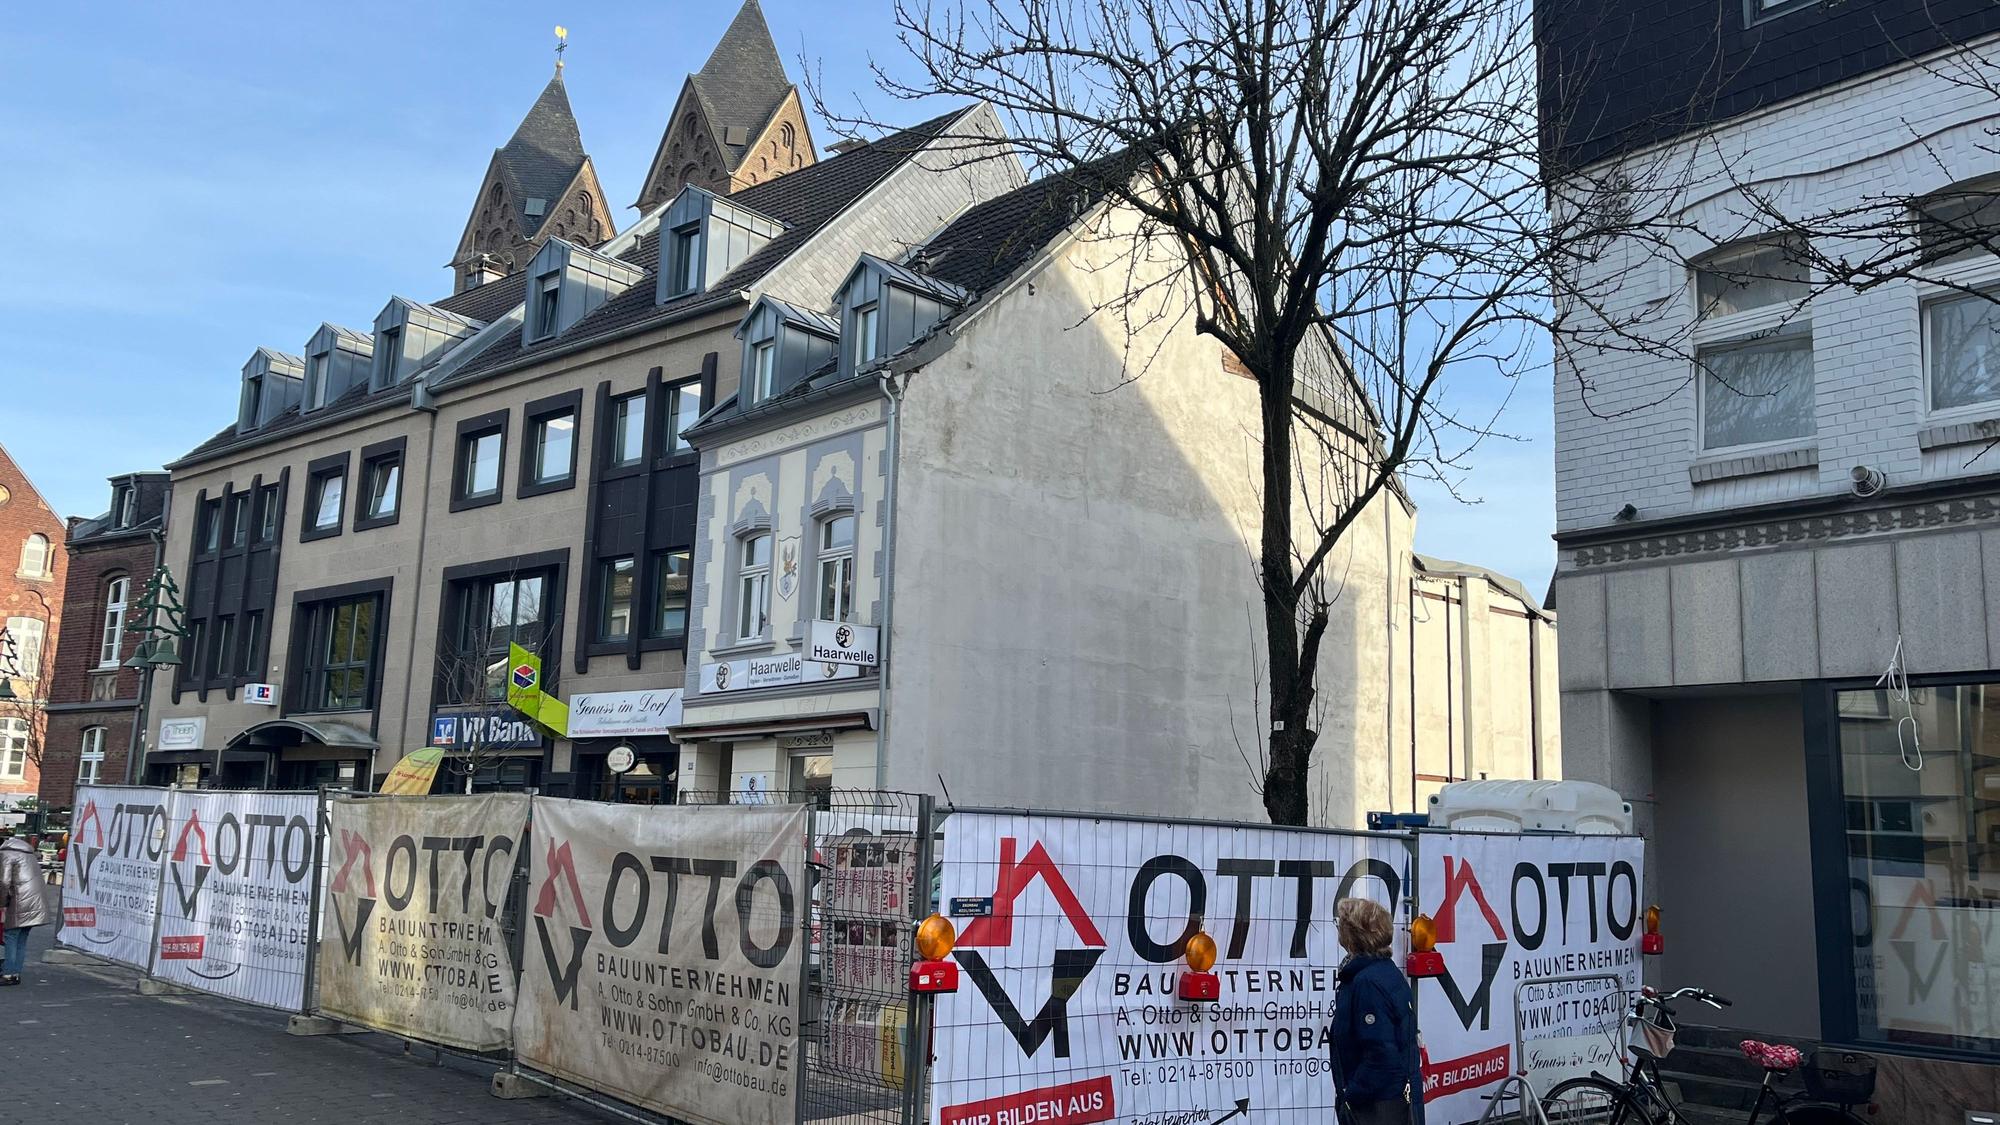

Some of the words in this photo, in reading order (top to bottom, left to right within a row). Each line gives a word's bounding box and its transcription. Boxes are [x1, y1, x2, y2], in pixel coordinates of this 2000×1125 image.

[751, 658, 801, 677] Haarwelle
[814, 645, 874, 663] Haarwelle
[576, 696, 615, 716] Genuss
[618, 700, 634, 713] im
[638, 691, 677, 717] Dorf
[463, 717, 486, 743] VR
[488, 716, 536, 743] Bank
[107, 803, 167, 862] OTTO
[214, 812, 312, 884] OTTO
[295, 911, 309, 924] KG
[602, 851, 795, 968] OTTO
[1126, 854, 1401, 963] OTTO
[1510, 860, 1637, 951] OTTO
[379, 940, 387, 954] A.
[389, 941, 408, 957] Otto
[410, 944, 417, 958] &
[421, 945, 445, 960] Sohn
[1514, 947, 1635, 980] BAUUNTERNEHMEN
[597, 953, 790, 1007] BAUUNTERNEHMEN
[1528, 986, 1545, 1002] Otto
[1548, 984, 1555, 999] &
[1605, 976, 1611, 990] &
[1626, 970, 1635, 985] KG
[598, 981, 607, 1000] A.
[611, 984, 633, 1006] Otto
[636, 990, 644, 1008] &
[648, 993, 683, 1015] Sohn
[687, 999, 725, 1023] GmbH
[732, 1006, 740, 1026] &
[745, 1009, 762, 1033] Co.
[768, 1013, 791, 1037] KG
[1116, 1006, 1136, 1026] A.
[1142, 1005, 1183, 1025] Otto
[1190, 1003, 1201, 1023] &
[1209, 1003, 1256, 1022] Sohn
[1263, 1001, 1322, 1021] GmbH
[1327, 1000, 1336, 1018] &
[601, 1004, 788, 1072] WWW.OTTOBAU.DE
[618, 1039, 680, 1068] 0214-87500
[694, 1056, 787, 1097] info@ottobau.de
[1442, 1066, 1483, 1087] BILDEN
[1484, 1056, 1505, 1076] AUS
[1529, 1050, 1567, 1070] Genuss
[1588, 1045, 1616, 1067] Dorf
[1121, 1068, 1152, 1087] Tel:
[1158, 1061, 1254, 1084] 0214-87500
[996, 1099, 1063, 1125] BILDEN
[1067, 1091, 1104, 1116] AUS
